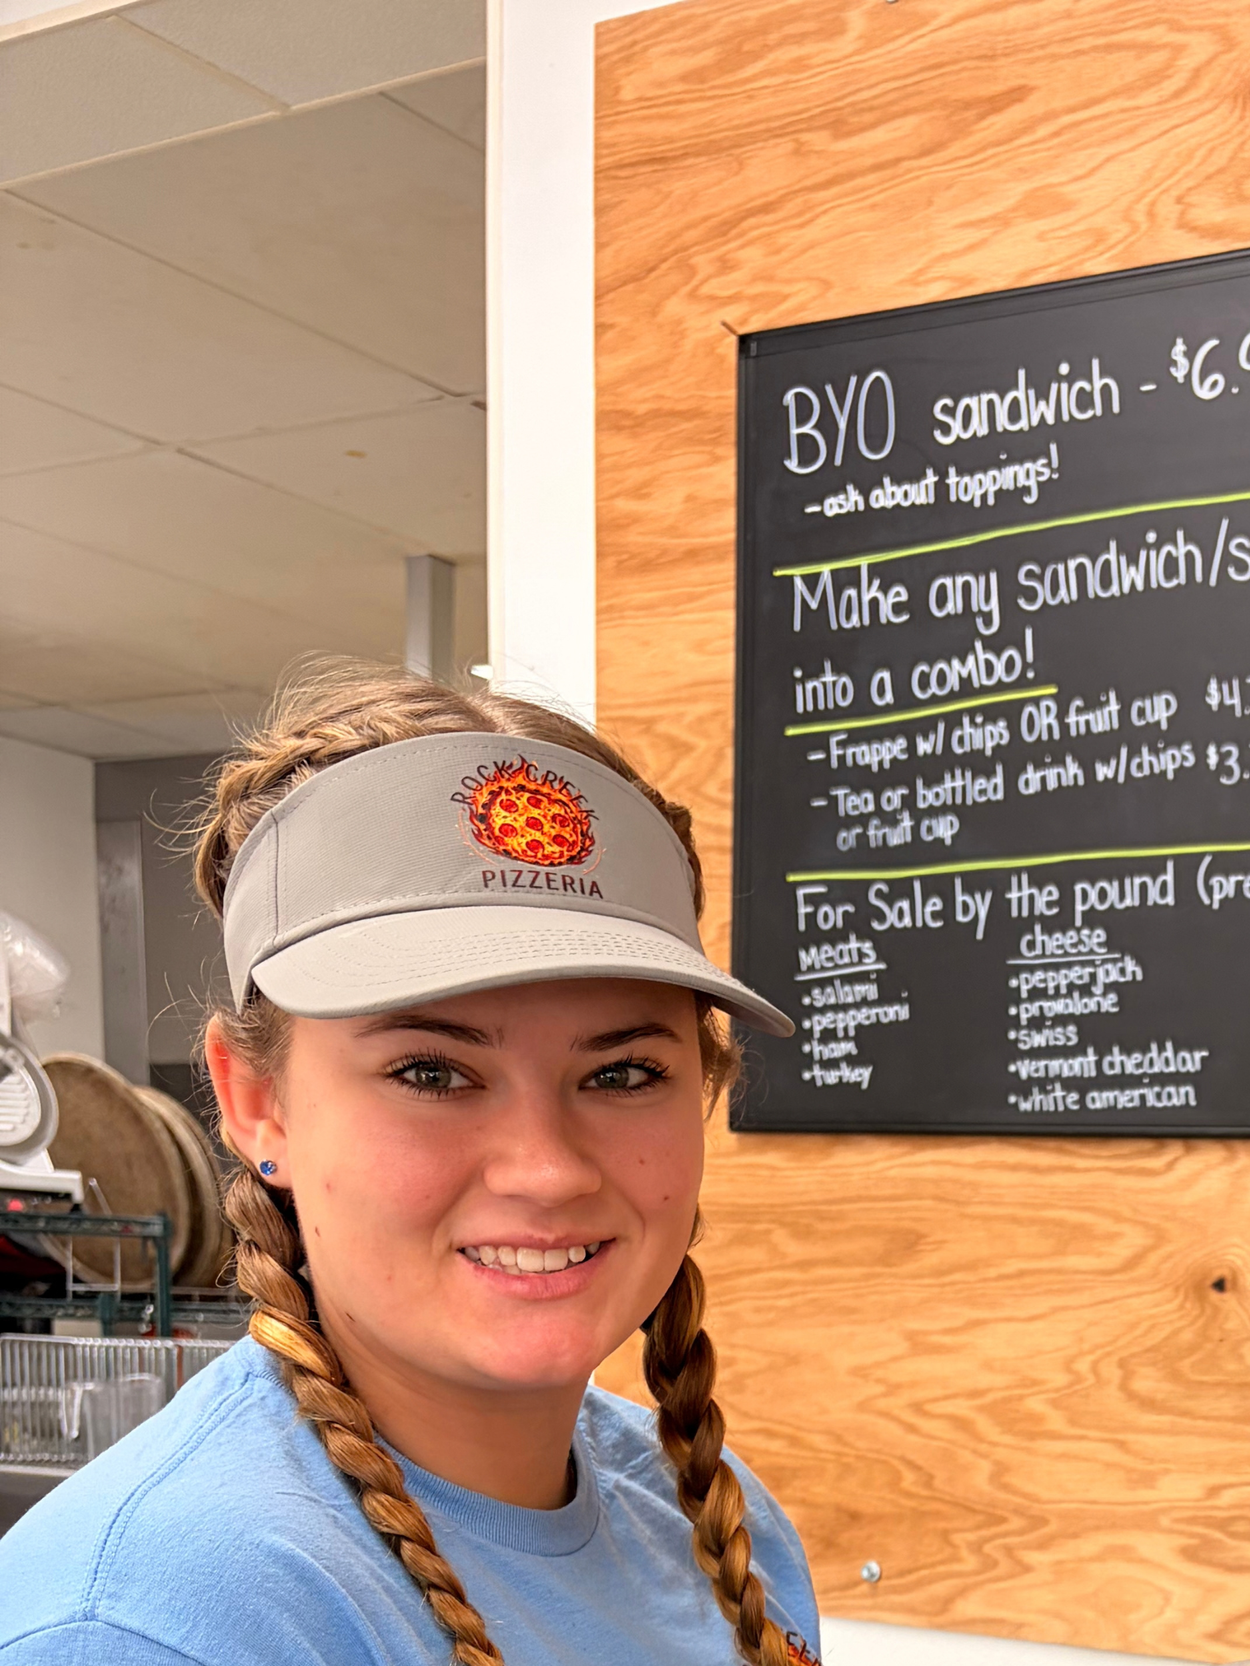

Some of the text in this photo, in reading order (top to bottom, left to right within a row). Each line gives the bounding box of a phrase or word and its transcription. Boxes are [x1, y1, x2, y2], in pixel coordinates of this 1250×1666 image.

[783, 370, 896, 474] BYO
[932, 356, 1119, 444] sandwich
[869, 473, 939, 509] about
[945, 440, 1060, 507] toppings!
[793, 561, 910, 632] Make
[928, 569, 1000, 635] any
[793, 625, 1034, 713] into a combo!
[951, 712, 1010, 757] chips
[1020, 698, 1060, 743] OR
[1065, 687, 1121, 737] fruit
[1131, 690, 1178, 730] cup
[450, 760, 600, 821] ROCK CREEK
[880, 785, 909, 812] or
[916, 761, 1004, 809] bottled
[1018, 752, 1085, 795] drink
[836, 808, 960, 851] or fruit cup
[481, 869, 604, 899] PIZZERIA
[796, 885, 855, 931] For
[868, 877, 944, 931] Sale
[955, 875, 993, 940] by
[1005, 871, 1060, 918] the
[1074, 858, 1175, 927] pound
[799, 932, 877, 971] Meats
[1020, 922, 1108, 957] cheese
[811, 972, 878, 1007] salami
[811, 990, 910, 1039] pepperoni
[1017, 1020, 1079, 1050] swiss
[811, 1039, 858, 1061] ham
[1016, 1038, 1209, 1080] vermont cheddar
[811, 1061, 873, 1090] turkey
[1017, 1076, 1197, 1112] white american
